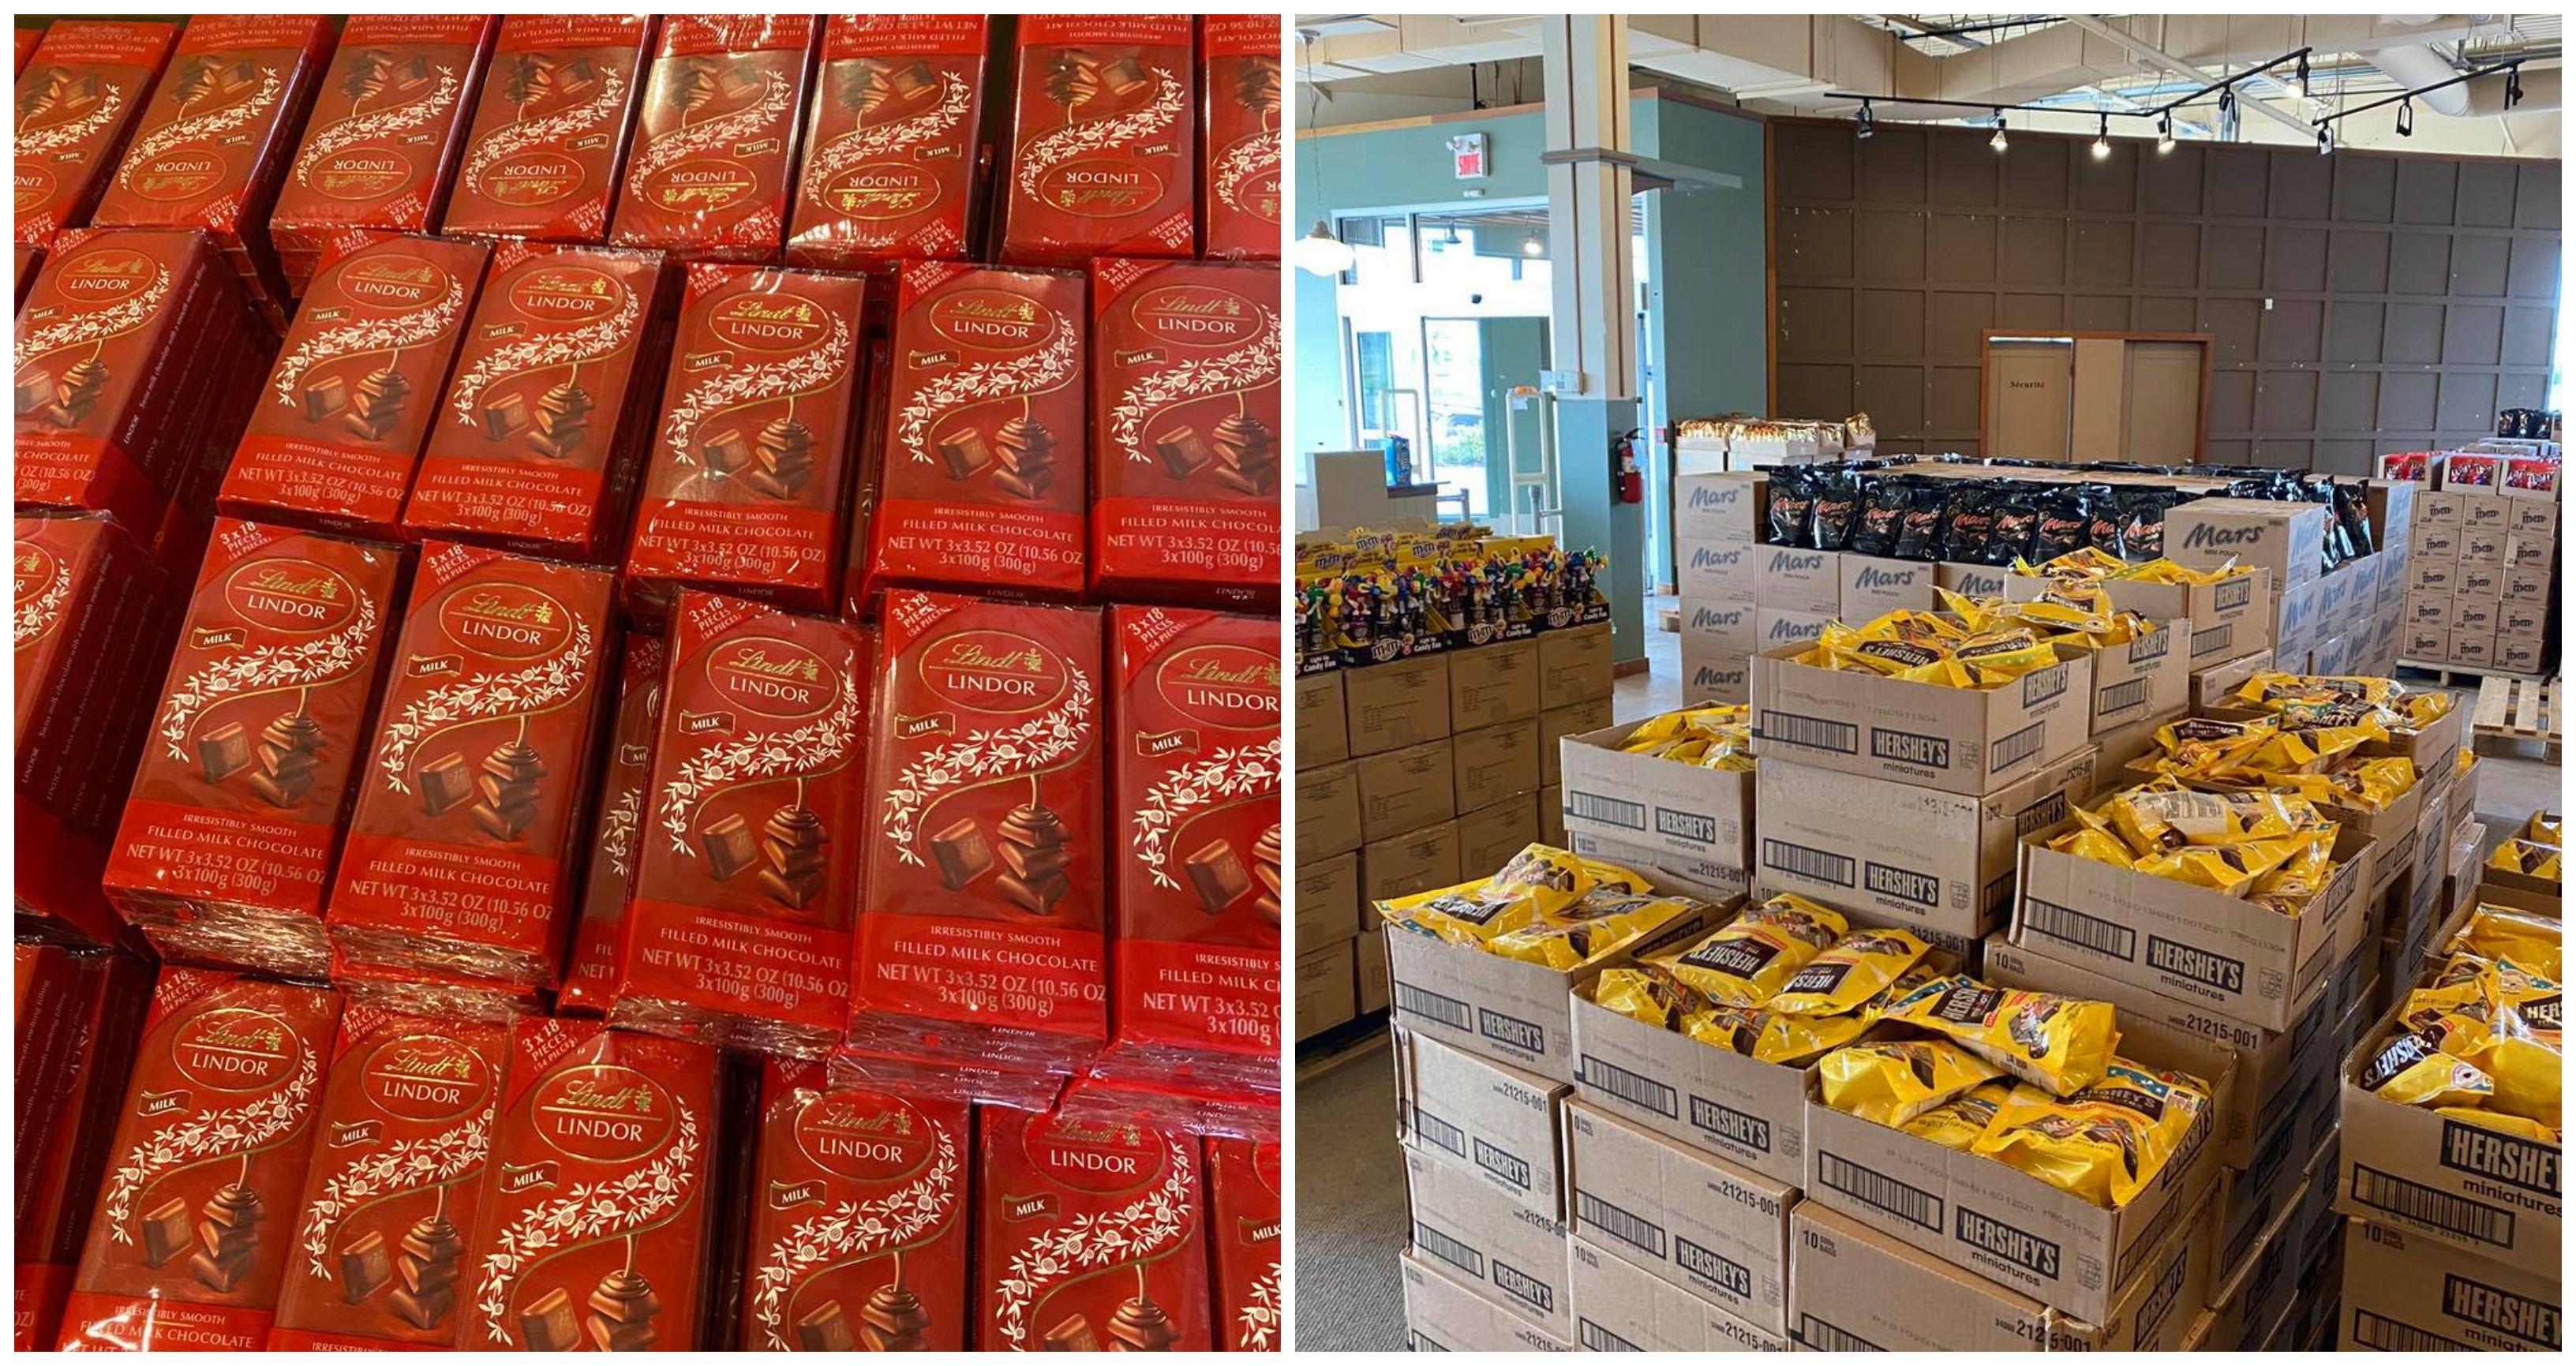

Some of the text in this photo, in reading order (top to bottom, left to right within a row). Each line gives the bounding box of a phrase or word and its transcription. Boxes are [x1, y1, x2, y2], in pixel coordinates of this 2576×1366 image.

[746, 141, 769, 152] MILK
[1146, 144, 1169, 154] MILK
[155, 162, 211, 171] LINDOR
[335, 160, 395, 170] LINDOR
[505, 165, 566, 174] LINDOR
[671, 173, 736, 182] LINDOR
[850, 175, 918, 190] LINDOR
[1066, 173, 1138, 184] LINDOR
[70, 279, 129, 290] LINDOR
[355, 282, 420, 299] LINDOR
[527, 296, 595, 310] LINDOR
[32, 309, 54, 319] MILK
[316, 310, 339, 320] MILK
[489, 326, 514, 337] MILK
[732, 323, 803, 339] LINDOR
[954, 320, 1028, 338] LINDOR
[1158, 318, 1236, 334] LINDOR
[696, 357, 720, 366] MILK
[921, 354, 947, 365] MILK
[1128, 353, 1153, 364] MILK
[1688, 486, 1739, 507] Mars
[1121, 518, 1207, 530] FILLED MILK
[1107, 536, 1242, 552] NET WT 3x3.52 OZ
[2183, 522, 2267, 551] Mars
[1217, 553, 1263, 570] (300g)
[1691, 546, 1740, 568] Mars
[1769, 549, 1823, 573] Mars
[1855, 566, 1915, 589] Mars
[1956, 572, 2003, 593] Mar
[248, 595, 325, 619] LINDOR
[1692, 606, 1741, 627] Mars
[204, 633, 231, 644] MILK
[463, 621, 541, 645] LINDOR
[1141, 619, 1174, 642] PIECES
[1769, 617, 1821, 640] Mars
[420, 661, 448, 673] MILK
[1694, 665, 1743, 686] Mars
[731, 676, 809, 703] LINDOR
[948, 675, 1035, 696] LINDOR
[1187, 690, 1279, 710] LINDOR
[691, 717, 721, 730] MILK
[908, 718, 939, 733] MILK
[1152, 735, 1182, 750] MILK
[1875, 732, 1945, 765] HERSHEY'S
[1883, 762, 1935, 779] miniatures
[1659, 811, 1713, 841] HERSHEY'S
[1700, 863, 1747, 884] 21215-001
[1869, 866, 1936, 902] HERSHEY'S
[1876, 896, 1926, 915] miniatures
[931, 926, 1061, 946] IRRESISTIBLY SMOOTH
[894, 941, 1096, 971] FILLED MILK CHOCOLATE
[1995, 952, 2008, 967] 10
[2152, 941, 2240, 989] HERSHEY'S
[878, 964, 909, 980] NET
[913, 967, 942, 982] WT
[945, 969, 996, 990] 3x3.52
[1002, 975, 1028, 991] OZ
[1032, 978, 1079, 997] (10.56
[2161, 975, 2225, 1001] miniatures
[938, 985, 1054, 1017] 3x100g (300g)
[1482, 1013, 1543, 1051] HERSHEY'S
[2187, 1014, 2257, 1049] 21215-001
[193, 1053, 268, 1076] LINDOR
[384, 1081, 459, 1104] LINDOR
[1503, 1083, 1547, 1113] 21215-001
[149, 1098, 176, 1110] MILK
[342, 1128, 369, 1142] MILK
[557, 1117, 642, 1143] LINDOR
[1694, 1102, 1767, 1149] HERSHEY'S
[820, 1138, 902, 1162] LINDOR
[1704, 1133, 1757, 1161] miniatures
[1050, 1150, 1136, 1174] LINDOR
[1477, 1141, 1529, 1186] HERSHEY'S
[515, 1170, 543, 1186] MILK
[782, 1188, 810, 1203] MILK
[1722, 1181, 1780, 1218] 21215-001
[1017, 1199, 1046, 1215] MILK
[1525, 1211, 1566, 1239] 21215-00
[2364, 1222, 2381, 1242] 10
[1803, 1230, 1818, 1248] 10
[1964, 1209, 2057, 1274] HERSHEY'S
[1680, 1241, 1748, 1295] HERSHEY'S
[1971, 1251, 2041, 1287] miniatures
[1496, 1263, 1552, 1309] HERSHEY'S
[1689, 1274, 1739, 1304] miniatures
